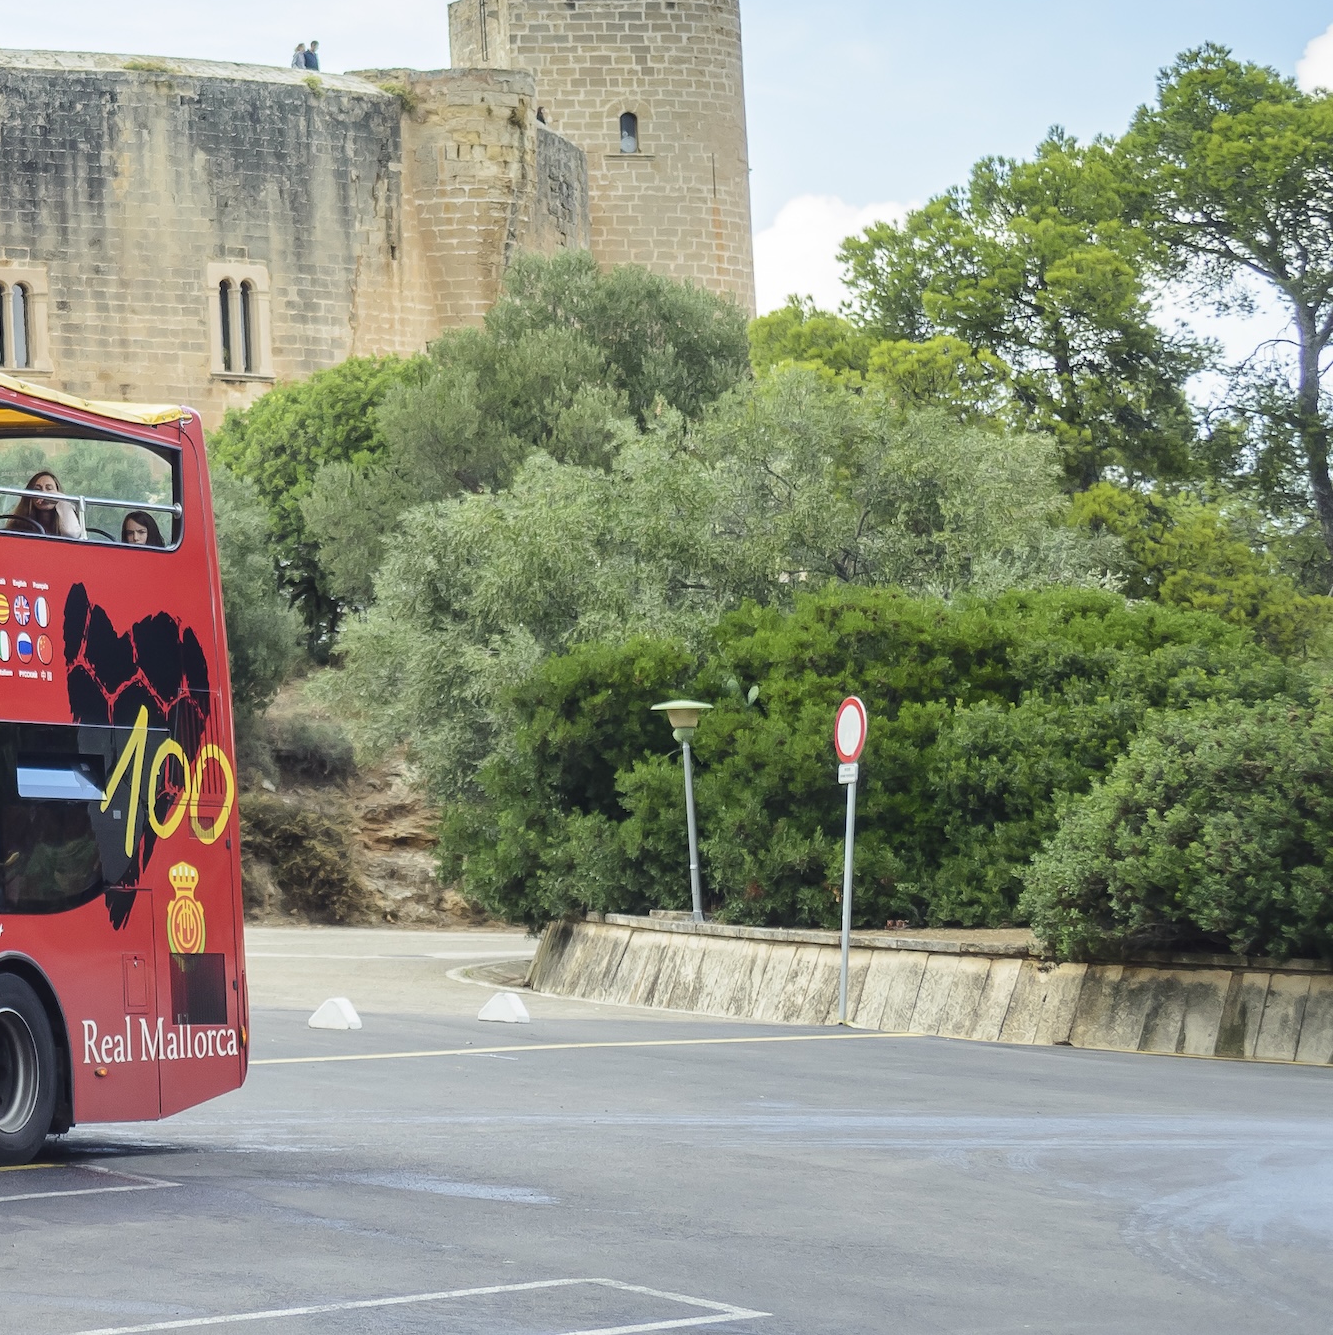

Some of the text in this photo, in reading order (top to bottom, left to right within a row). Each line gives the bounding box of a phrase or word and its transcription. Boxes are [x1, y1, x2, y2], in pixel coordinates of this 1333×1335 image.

[100, 704, 235, 859] 100
[81, 1015, 239, 1064] Real Mallorca
